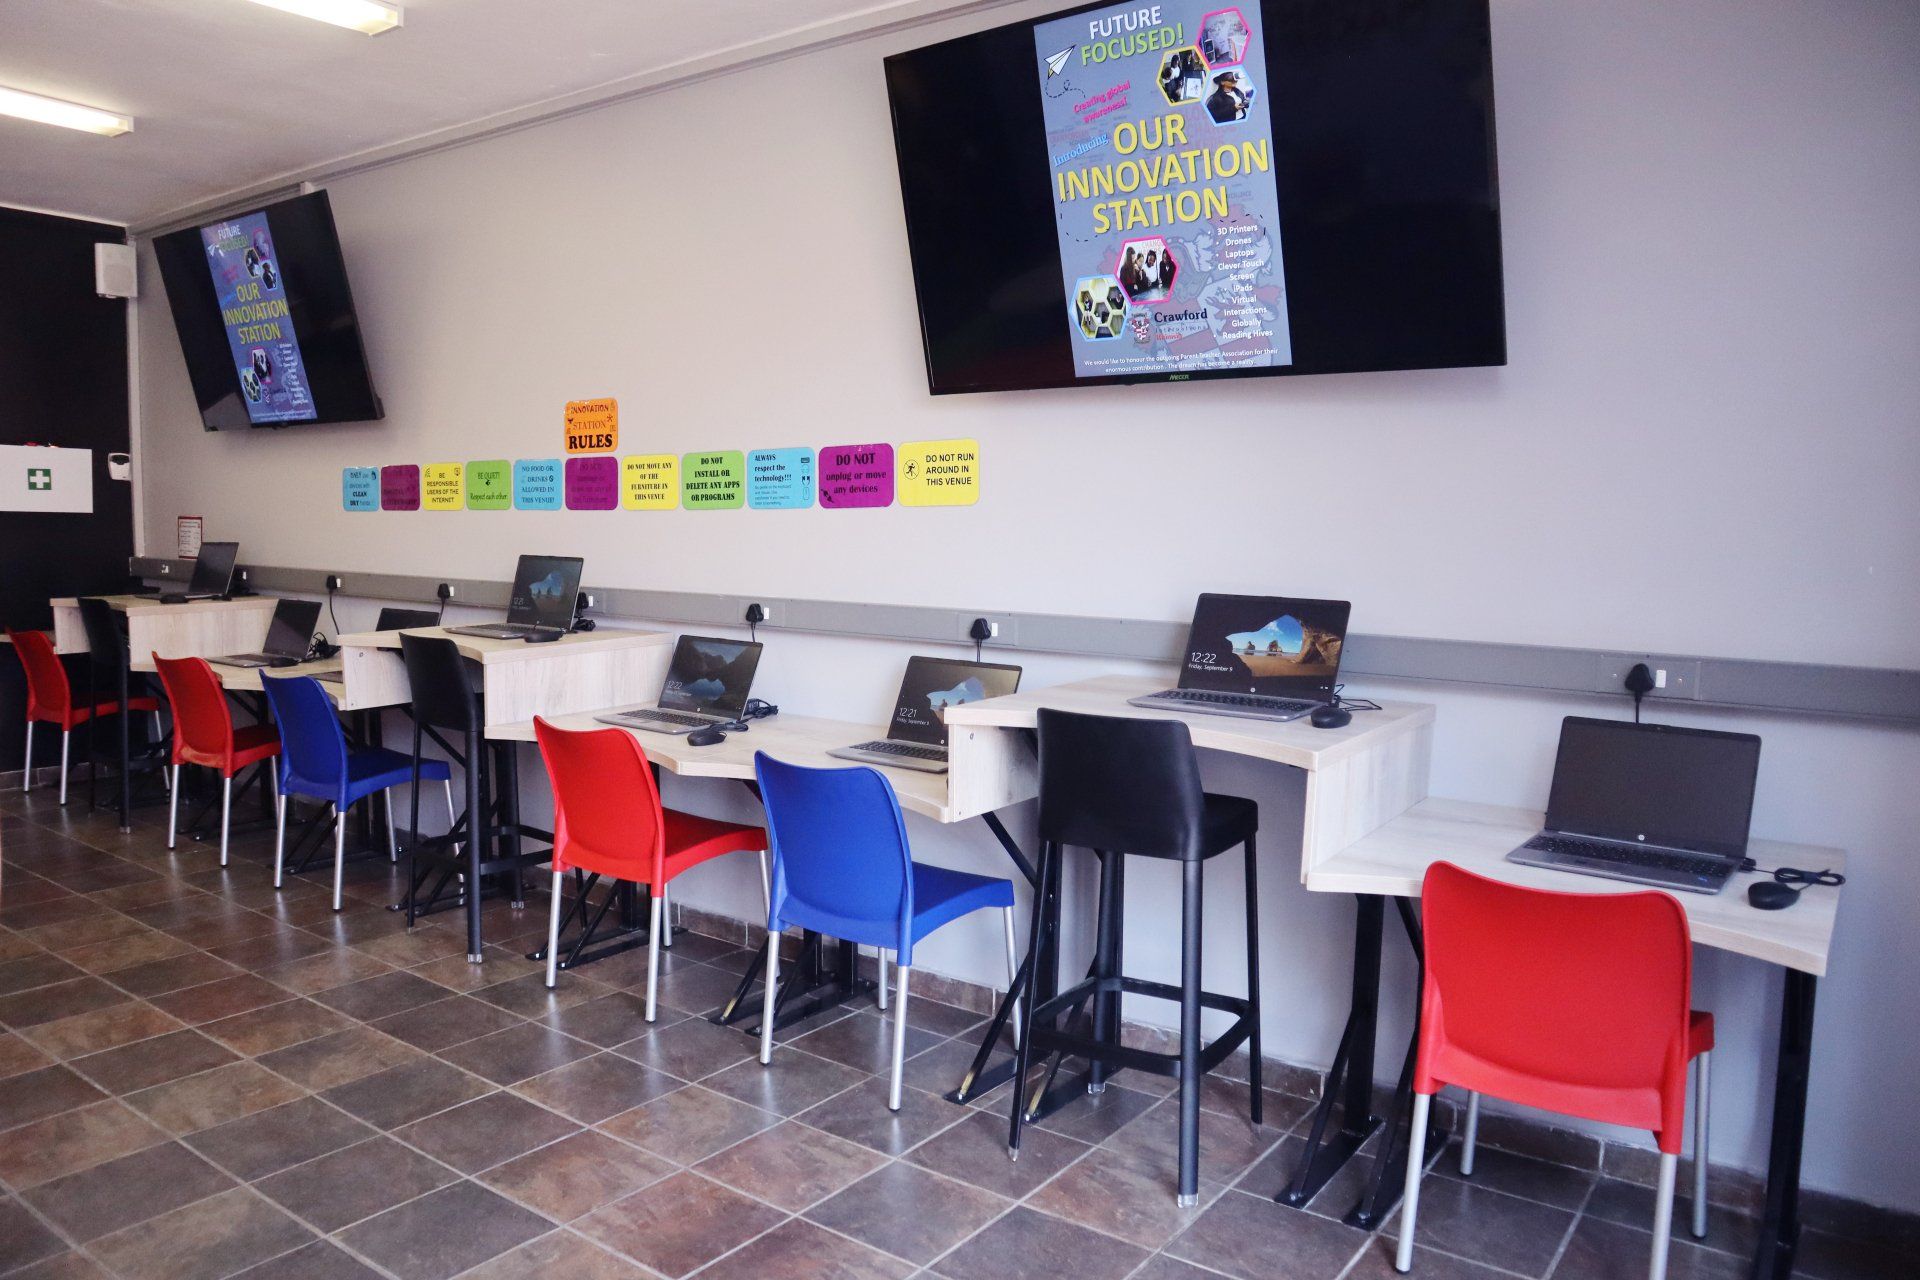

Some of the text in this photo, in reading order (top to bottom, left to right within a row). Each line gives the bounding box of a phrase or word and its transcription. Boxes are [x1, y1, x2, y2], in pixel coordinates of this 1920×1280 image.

[1089, 5, 1162, 40] FUTURE
[1080, 22, 1184, 66] FOCUSED!
[1113, 113, 1187, 155] OUR
[1052, 133, 1109, 167] Introducing
[1057, 139, 1269, 202] INNOVATION
[1092, 186, 1229, 234] STATION
[218, 224, 241, 239] FUTURE
[1217, 224, 1258, 235] 3D Printers
[1225, 237, 1252, 246] Drones
[1225, 249, 1255, 259] Laptops
[1218, 259, 1265, 270] Clever Touch
[236, 282, 260, 302] OUR
[1233, 284, 1253, 292] iPads
[1232, 295, 1257, 304] Virtual
[224, 299, 288, 325] INNOVATION
[1154, 308, 1208, 323] Crawford
[1224, 307, 1267, 316] Interactions
[1232, 319, 1261, 328] Globally
[239, 323, 281, 344] STATION
[1223, 329, 1273, 340] Reading Hives
[1222, 349, 1254, 357] Association
[571, 404, 608, 414] INNOVATION
[573, 420, 606, 430] STATION
[569, 434, 612, 449] RULES
[836, 453, 875, 466] DO NOT
[925, 453, 974, 463] DO NOT RUN
[694, 469, 730, 478] INSTALL OR
[926, 465, 969, 474] AROUND IN
[754, 474, 792, 482] technology!!!
[826, 472, 851, 482] unplug
[865, 471, 886, 479] move
[926, 477, 972, 486] THIS VENUE
[686, 482, 708, 490] DELETE
[710, 481, 722, 489] ANY
[834, 484, 878, 494] any devices
[700, 493, 735, 501] PROGRAMS
[1191, 652, 1217, 664] 12:22
[900, 707, 918, 717] 12:21
